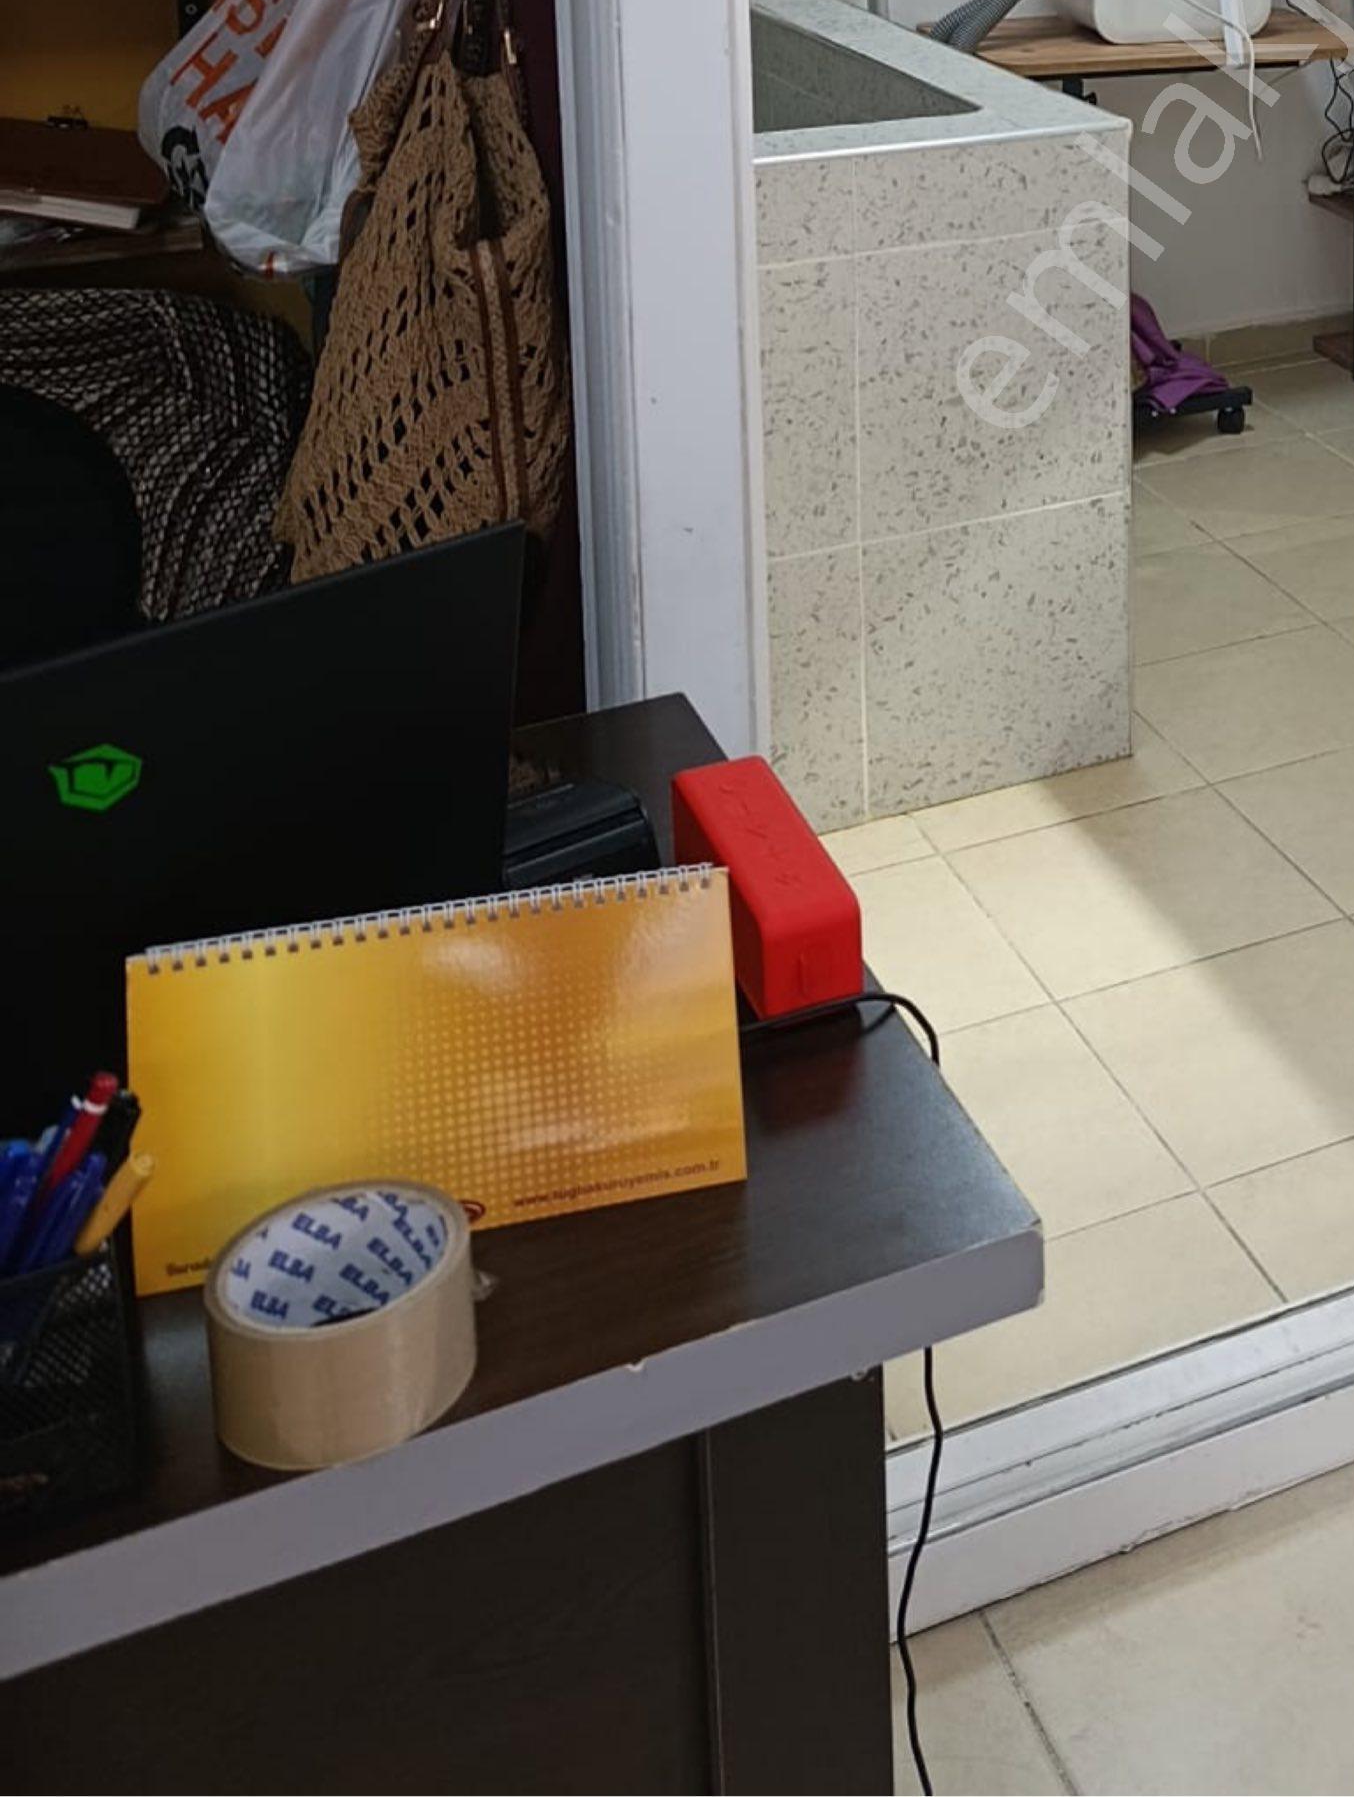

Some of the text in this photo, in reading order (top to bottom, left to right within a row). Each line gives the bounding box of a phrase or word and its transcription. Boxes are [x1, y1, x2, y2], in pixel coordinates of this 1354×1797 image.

[292, 1212, 342, 1251] ELBA
[392, 1216, 432, 1271] ELBA
[268, 1249, 315, 1283] ELBA
[366, 1236, 413, 1287] ELBA
[339, 1263, 390, 1307] ELBA
